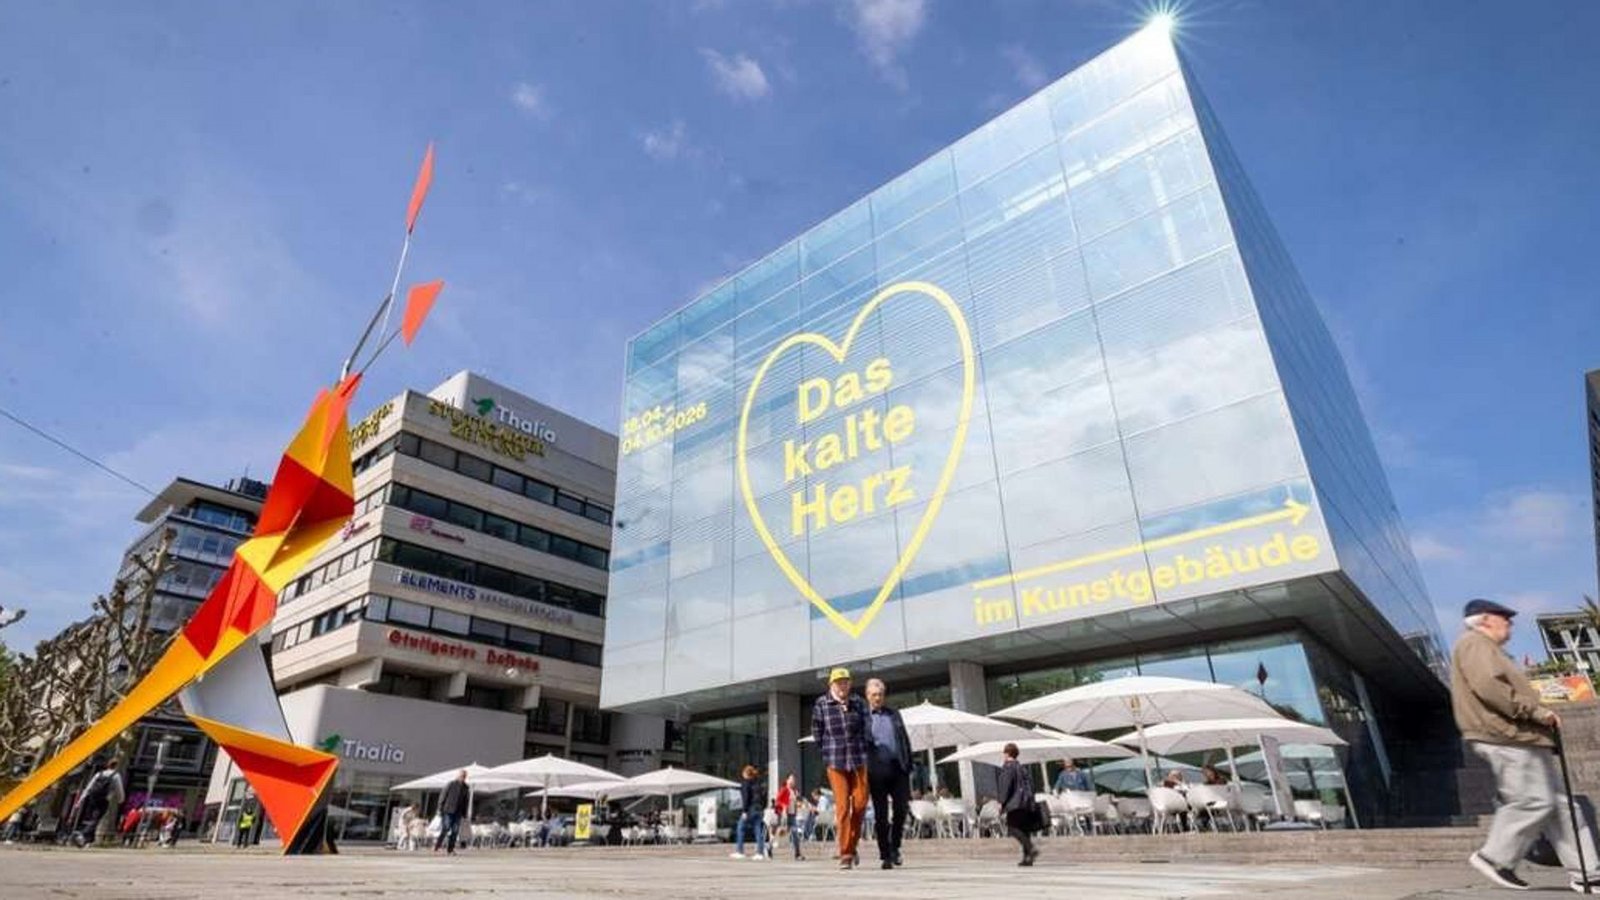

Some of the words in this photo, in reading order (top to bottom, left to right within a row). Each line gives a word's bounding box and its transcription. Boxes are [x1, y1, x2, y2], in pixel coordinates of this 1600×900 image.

[497, 404, 556, 443] Thalia
[798, 358, 893, 424] Das
[784, 405, 916, 483] kalte
[791, 465, 917, 537] Herz
[399, 571, 477, 601] ELEMENTS
[974, 597, 1014, 626] im
[1021, 532, 1321, 616] Kunstgebäude
[343, 739, 404, 763] Thalia
